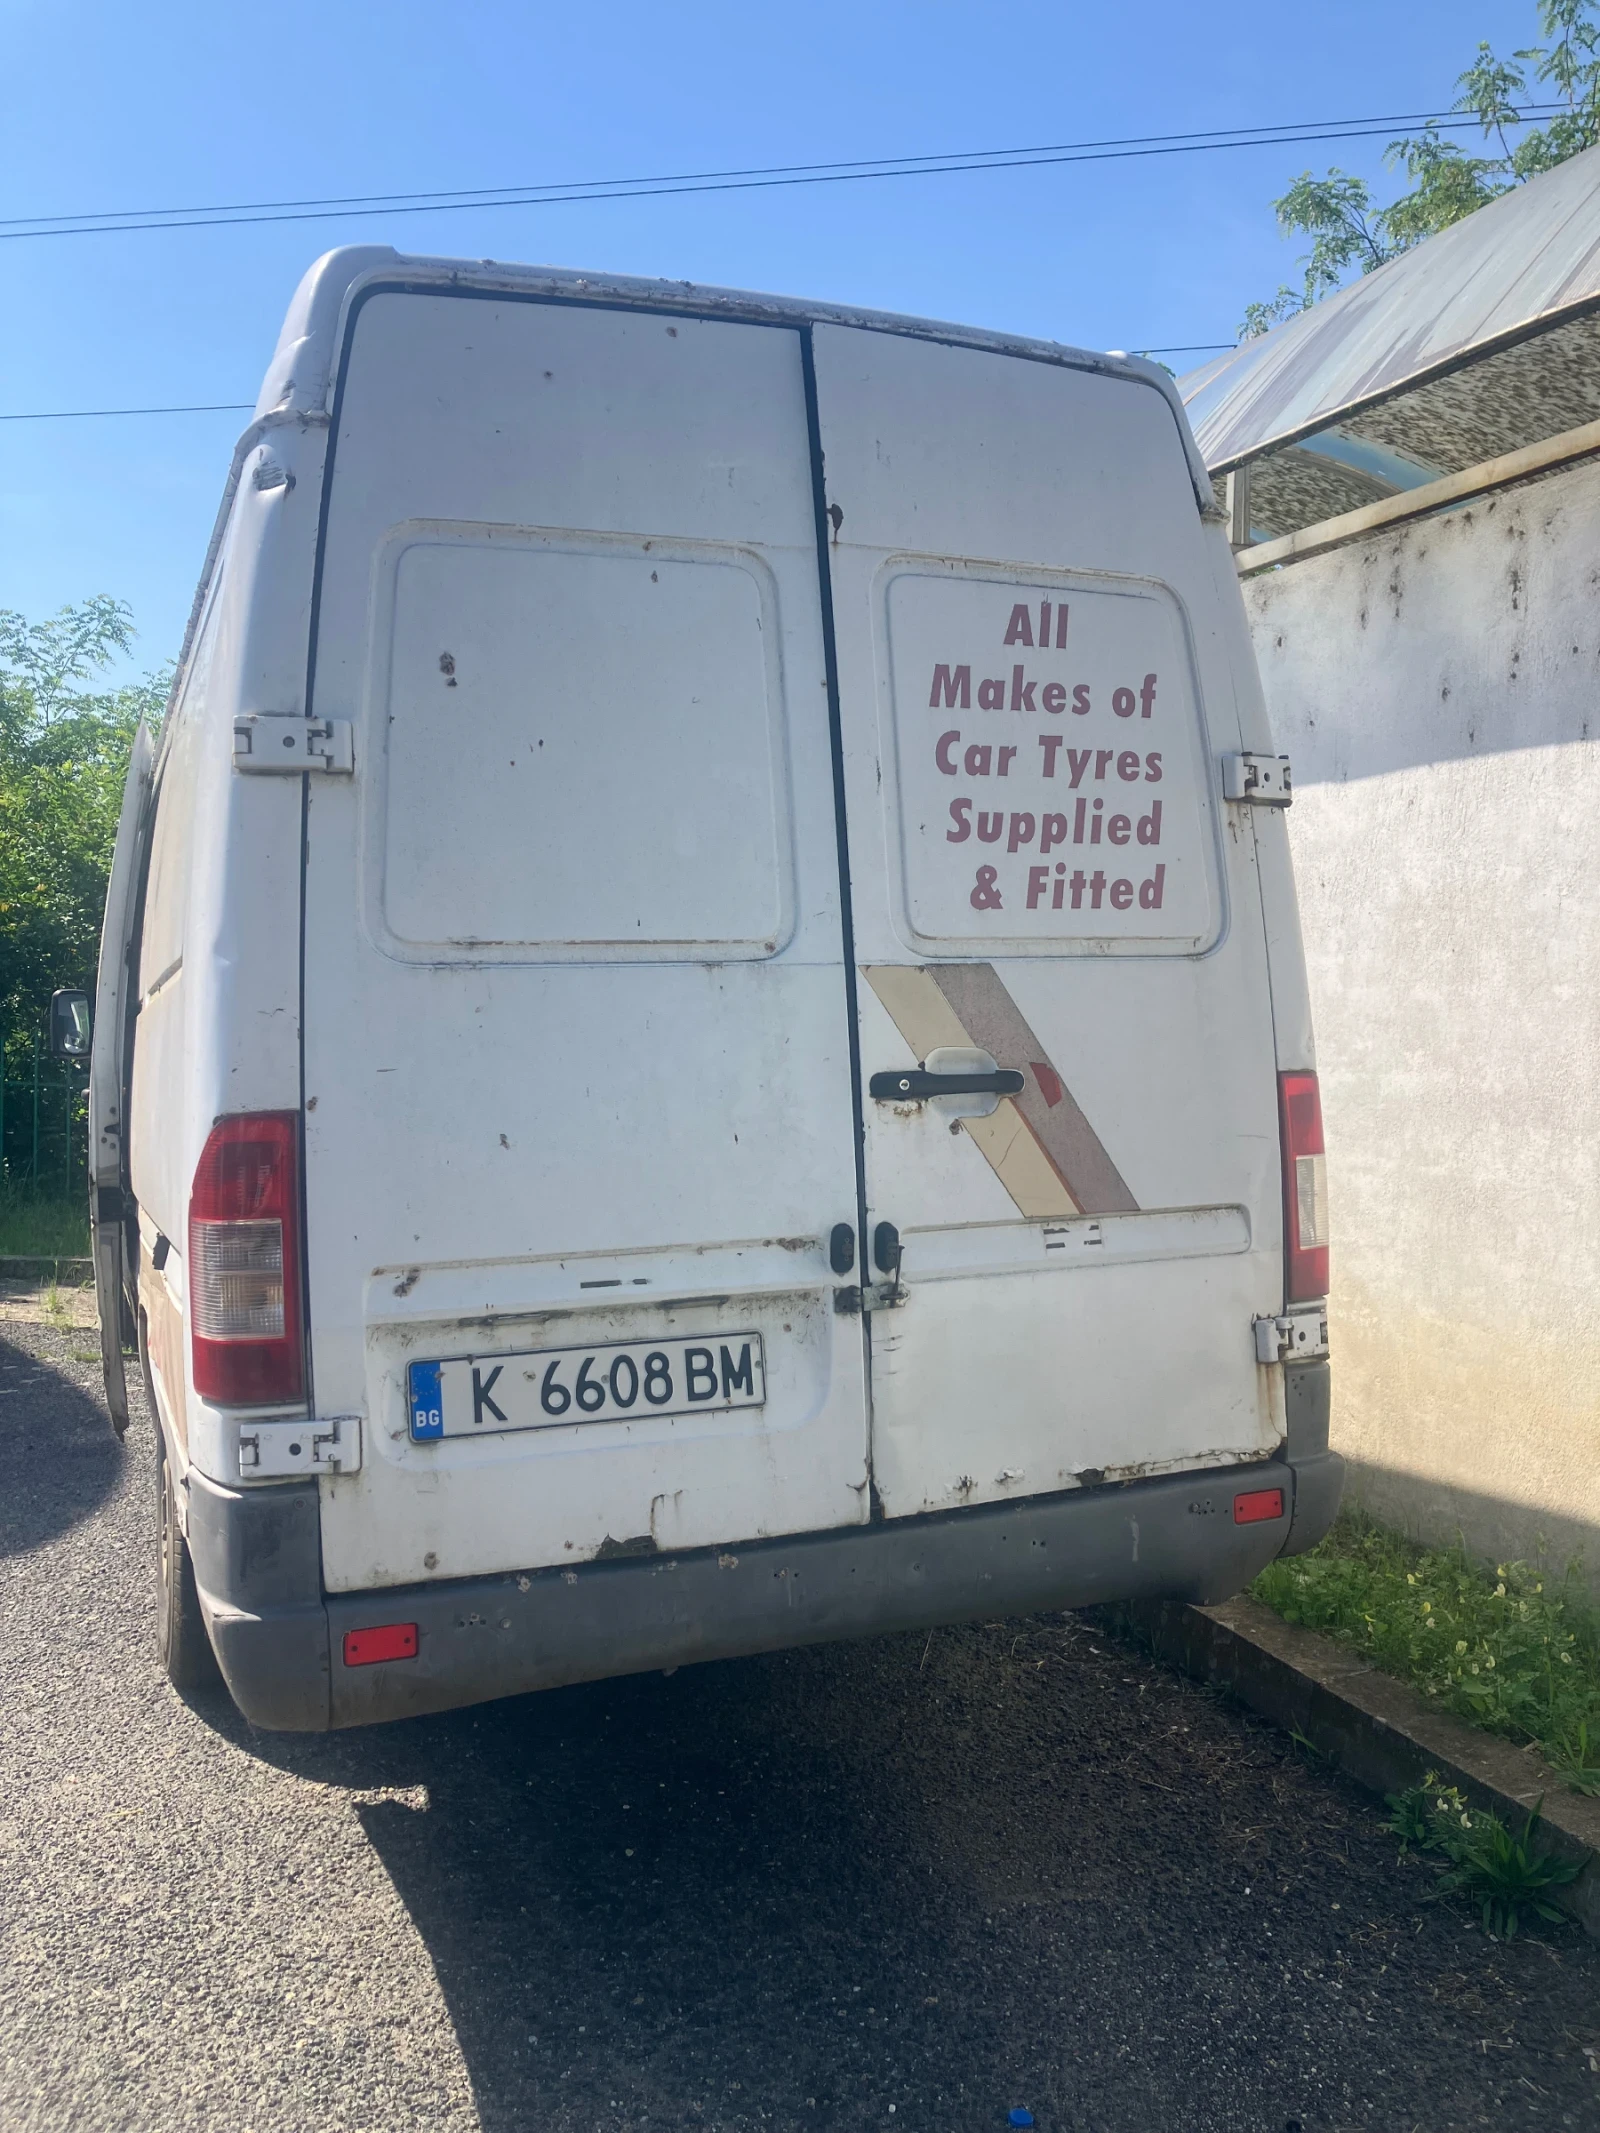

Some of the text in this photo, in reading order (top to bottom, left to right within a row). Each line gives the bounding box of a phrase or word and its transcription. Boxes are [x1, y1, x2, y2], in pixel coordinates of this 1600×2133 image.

[1003, 602, 1069, 649] All
[929, 664, 1157, 718] Makes of
[935, 730, 1163, 788] Car Tyres
[946, 798, 1162, 853] Supplied
[970, 862, 1166, 910] & Fitted
[415, 1410, 440, 1427] BG
[472, 1366, 508, 1424] K
